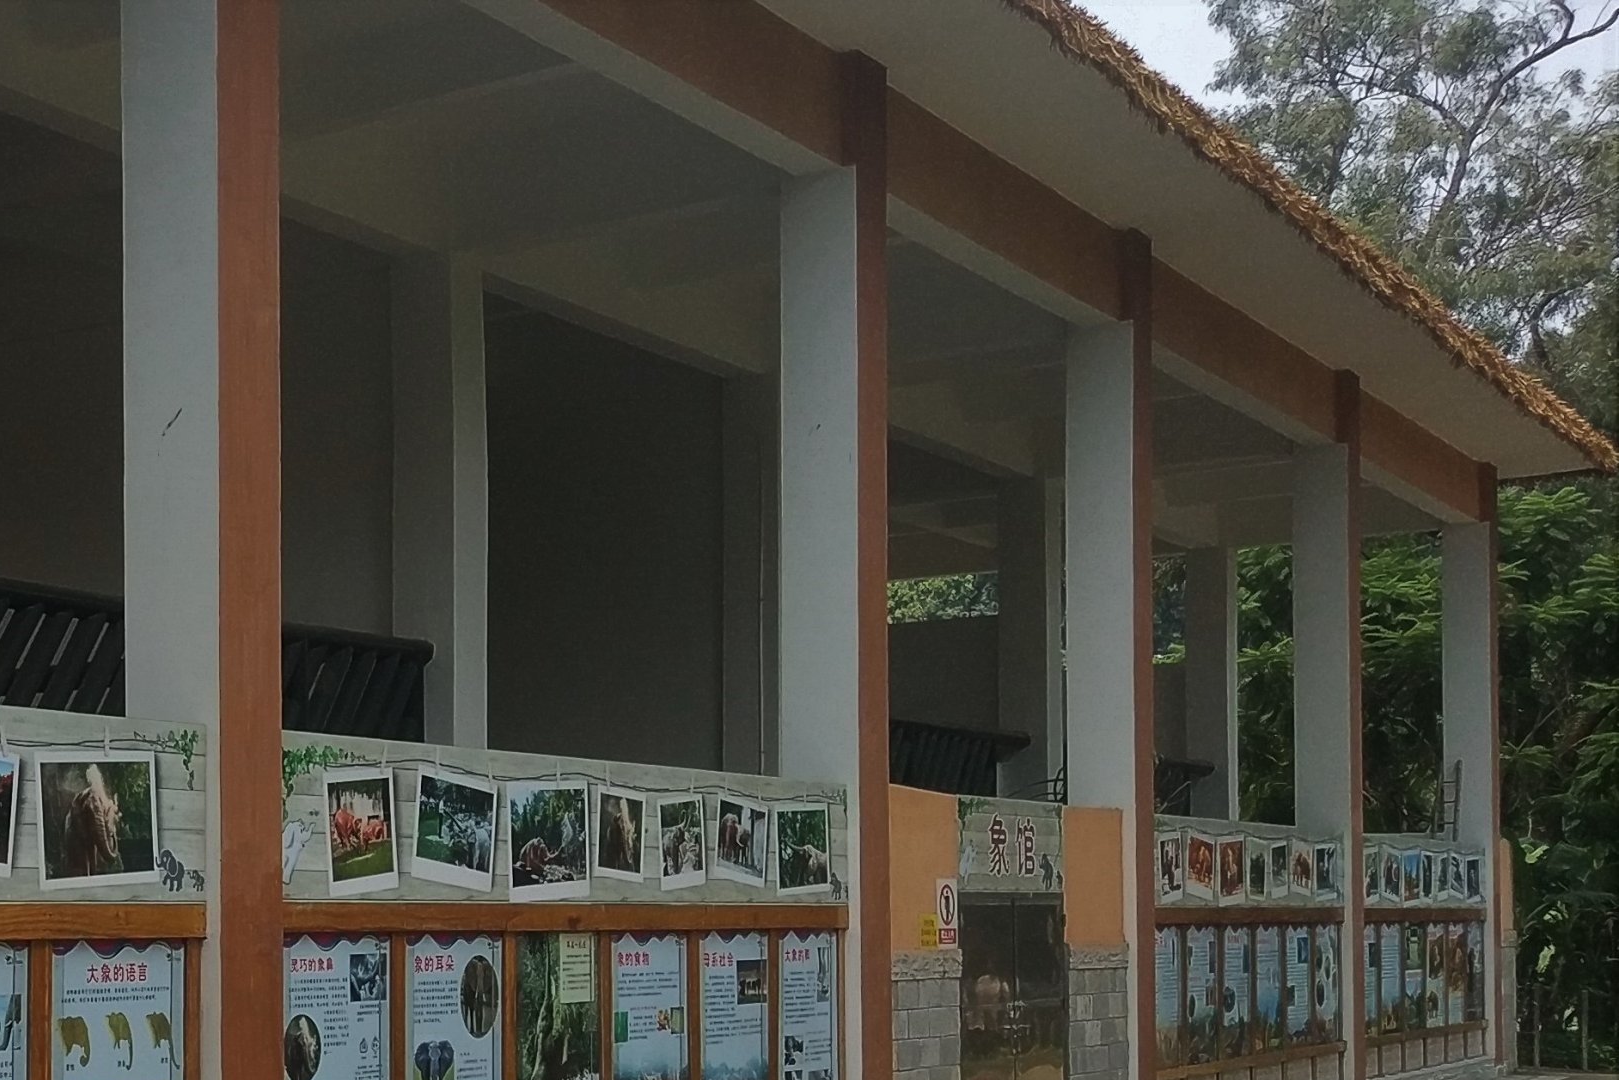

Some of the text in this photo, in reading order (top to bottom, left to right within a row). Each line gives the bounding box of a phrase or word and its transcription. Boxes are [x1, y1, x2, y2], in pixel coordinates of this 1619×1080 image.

[987, 813, 1036, 878] 象馆
[86, 962, 148, 983] 大象的语言
[414, 955, 455, 974] 象的耳朵
